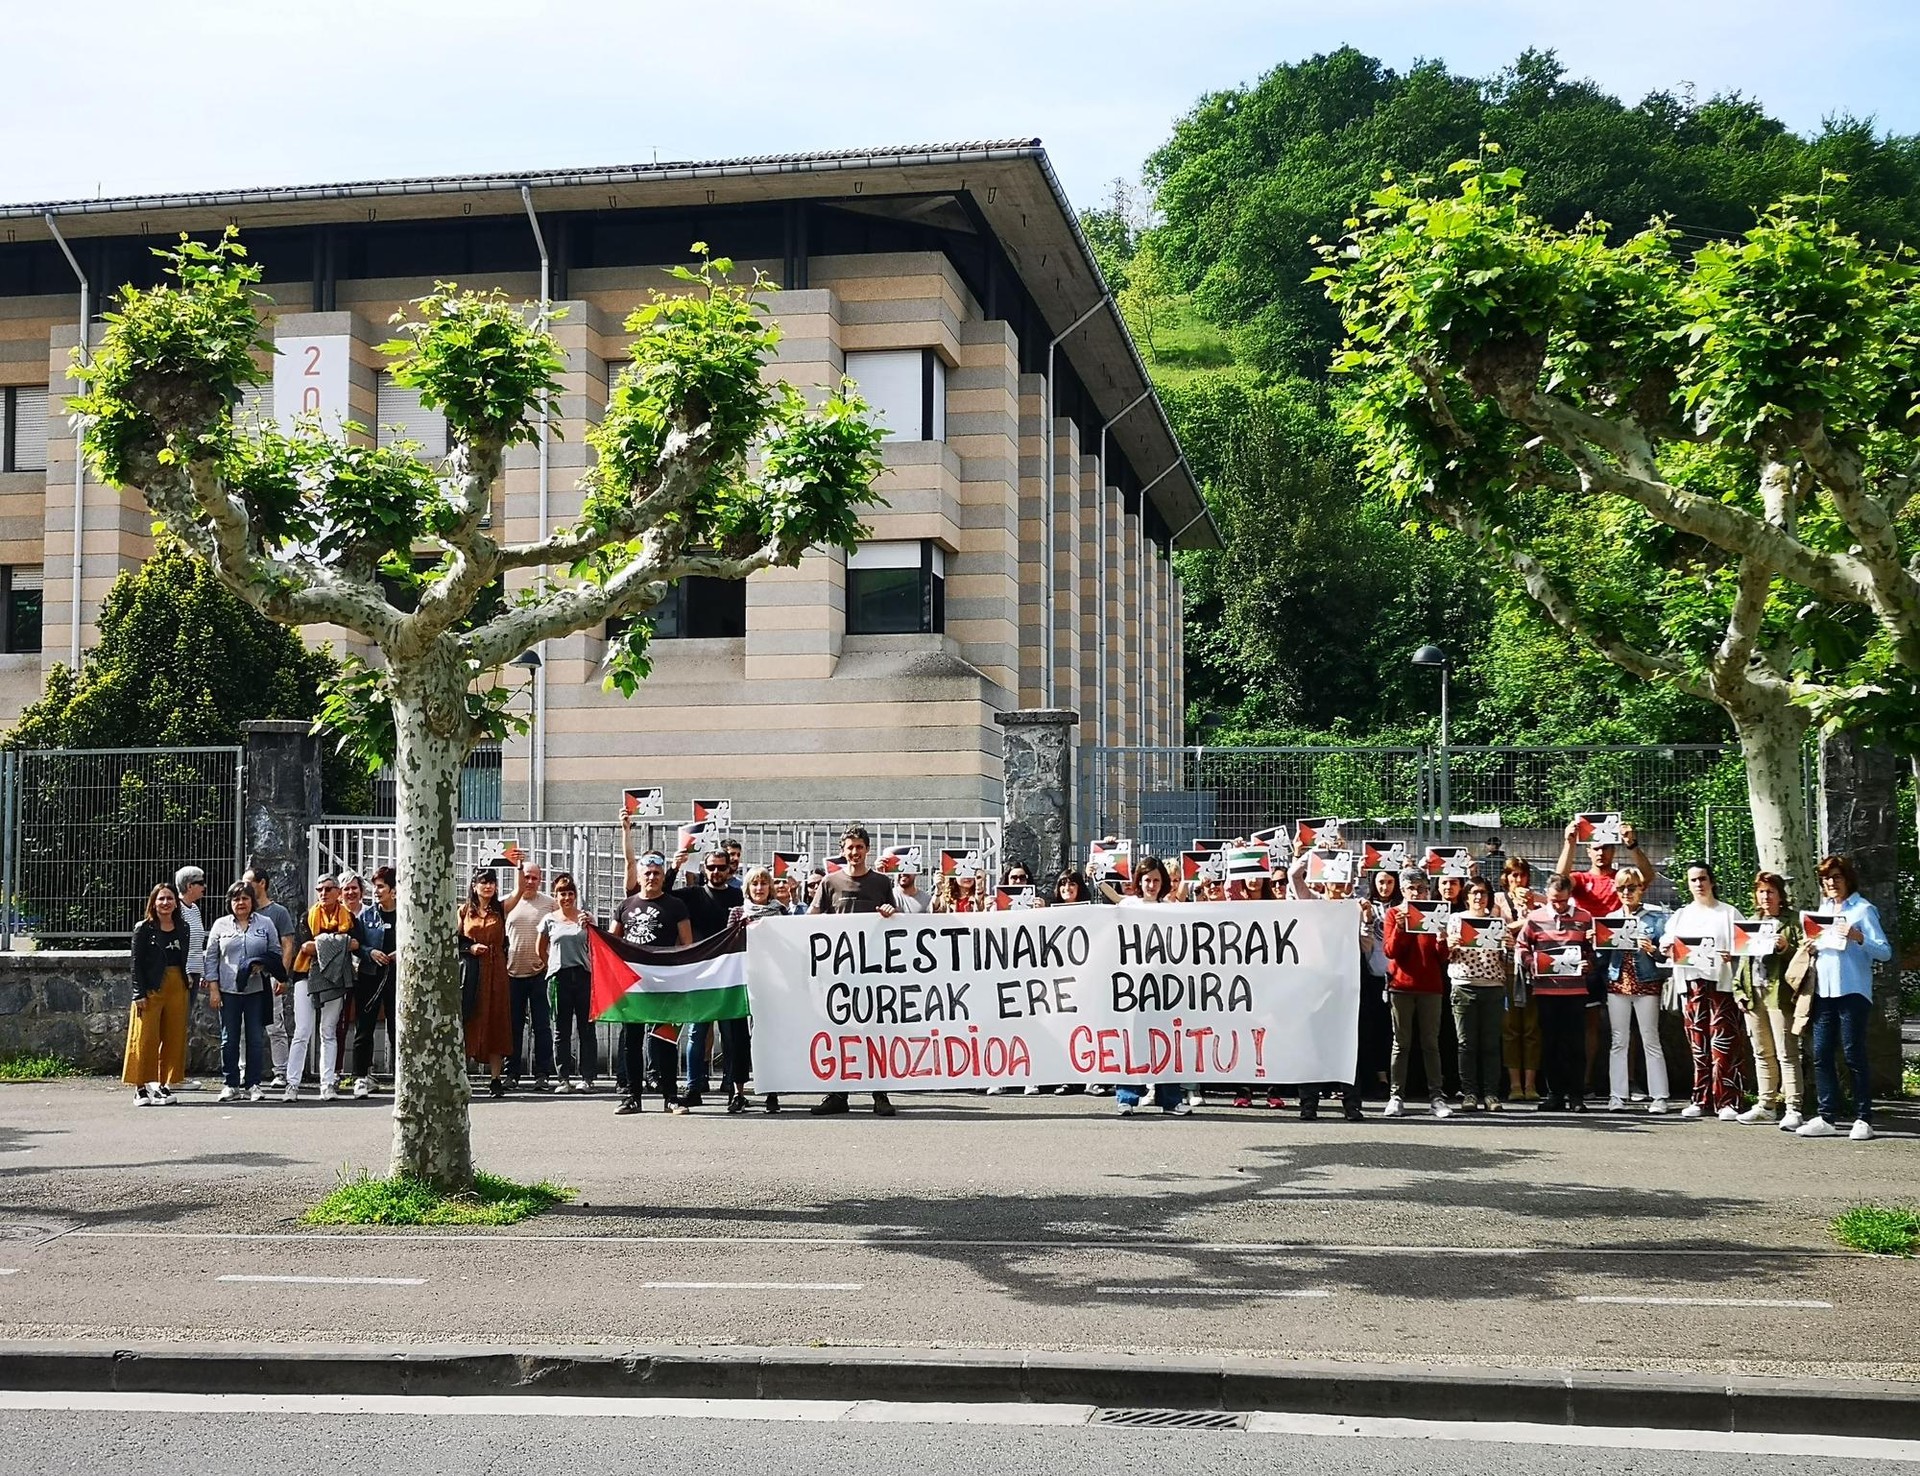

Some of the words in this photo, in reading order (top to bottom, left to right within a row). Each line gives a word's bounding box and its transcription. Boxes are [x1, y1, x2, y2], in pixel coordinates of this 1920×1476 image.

[809, 924, 1091, 978] PALESTINAKO
[1117, 918, 1300, 966] HAURRAK
[826, 982, 971, 1026] GUREAK
[996, 976, 1078, 1020] ERE
[1110, 971, 1254, 1014] BADIRA
